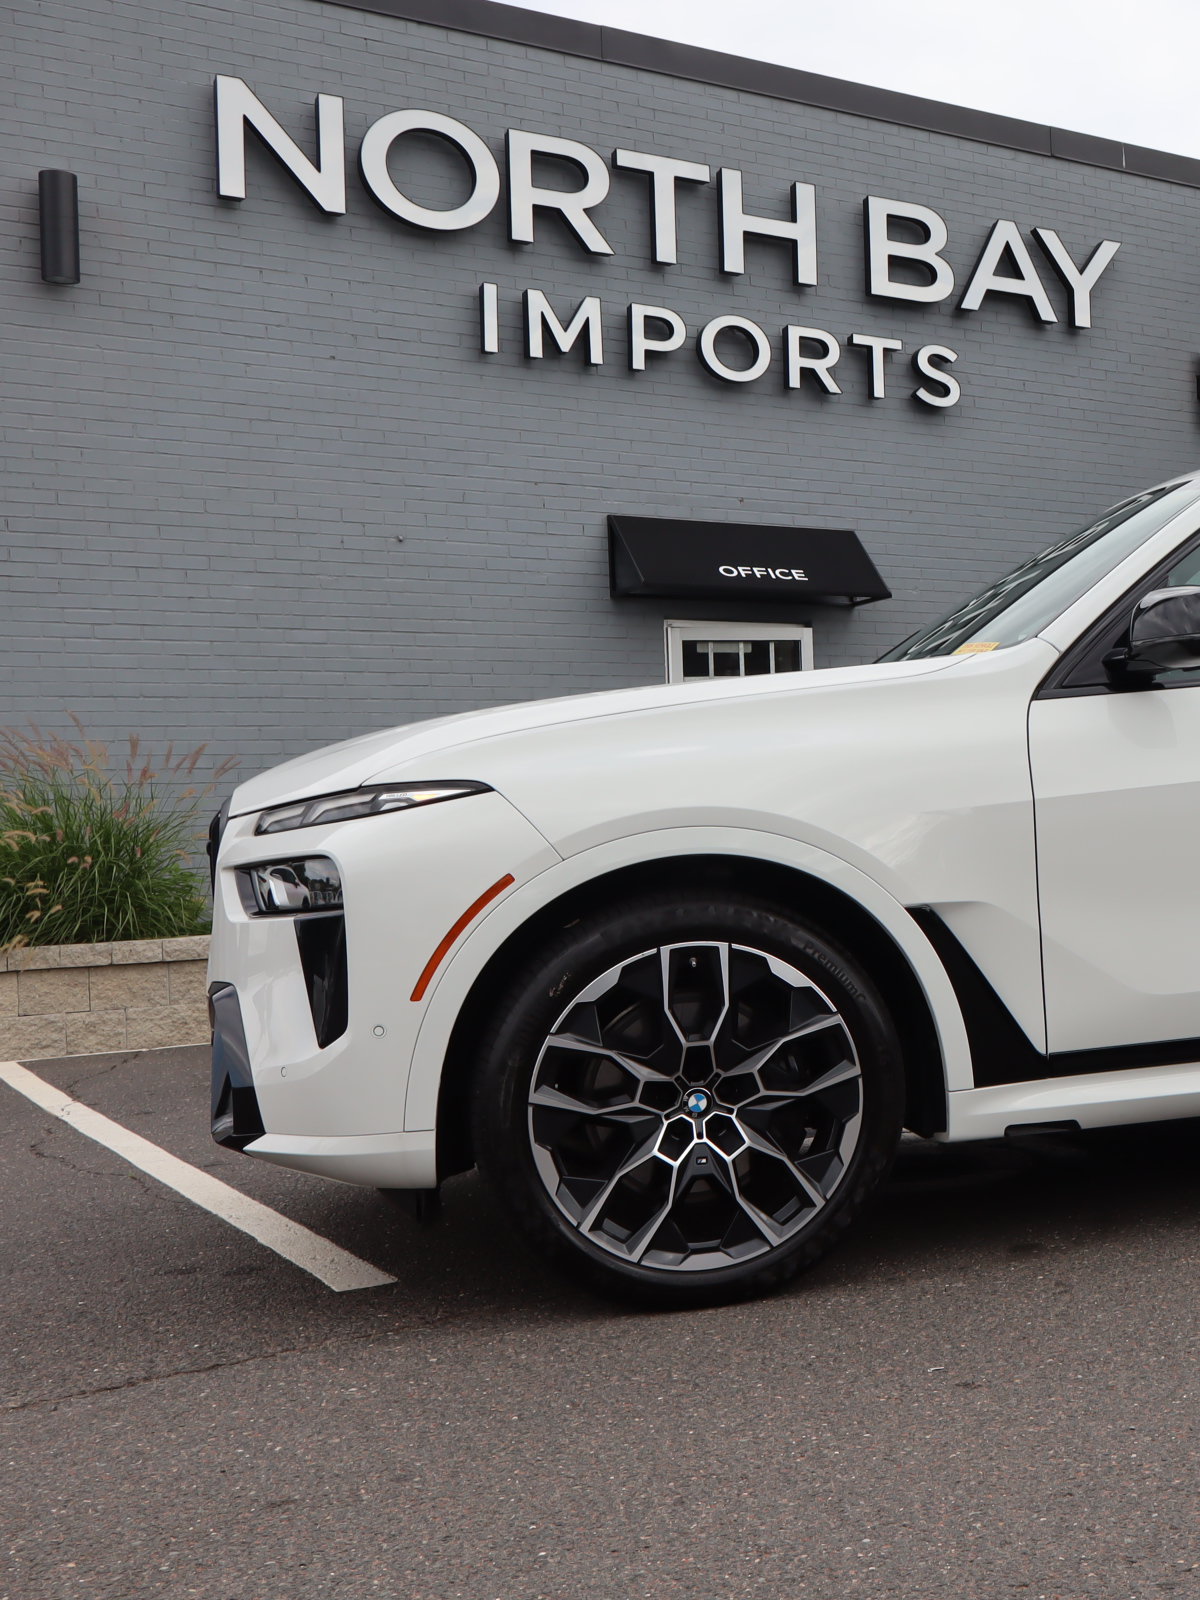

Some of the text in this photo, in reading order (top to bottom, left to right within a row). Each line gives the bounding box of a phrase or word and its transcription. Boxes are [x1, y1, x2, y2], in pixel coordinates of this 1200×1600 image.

[214, 75, 1121, 329] NORTH BAY
[481, 282, 961, 408] IMPORTS
[718, 565, 809, 581] OFFICE
